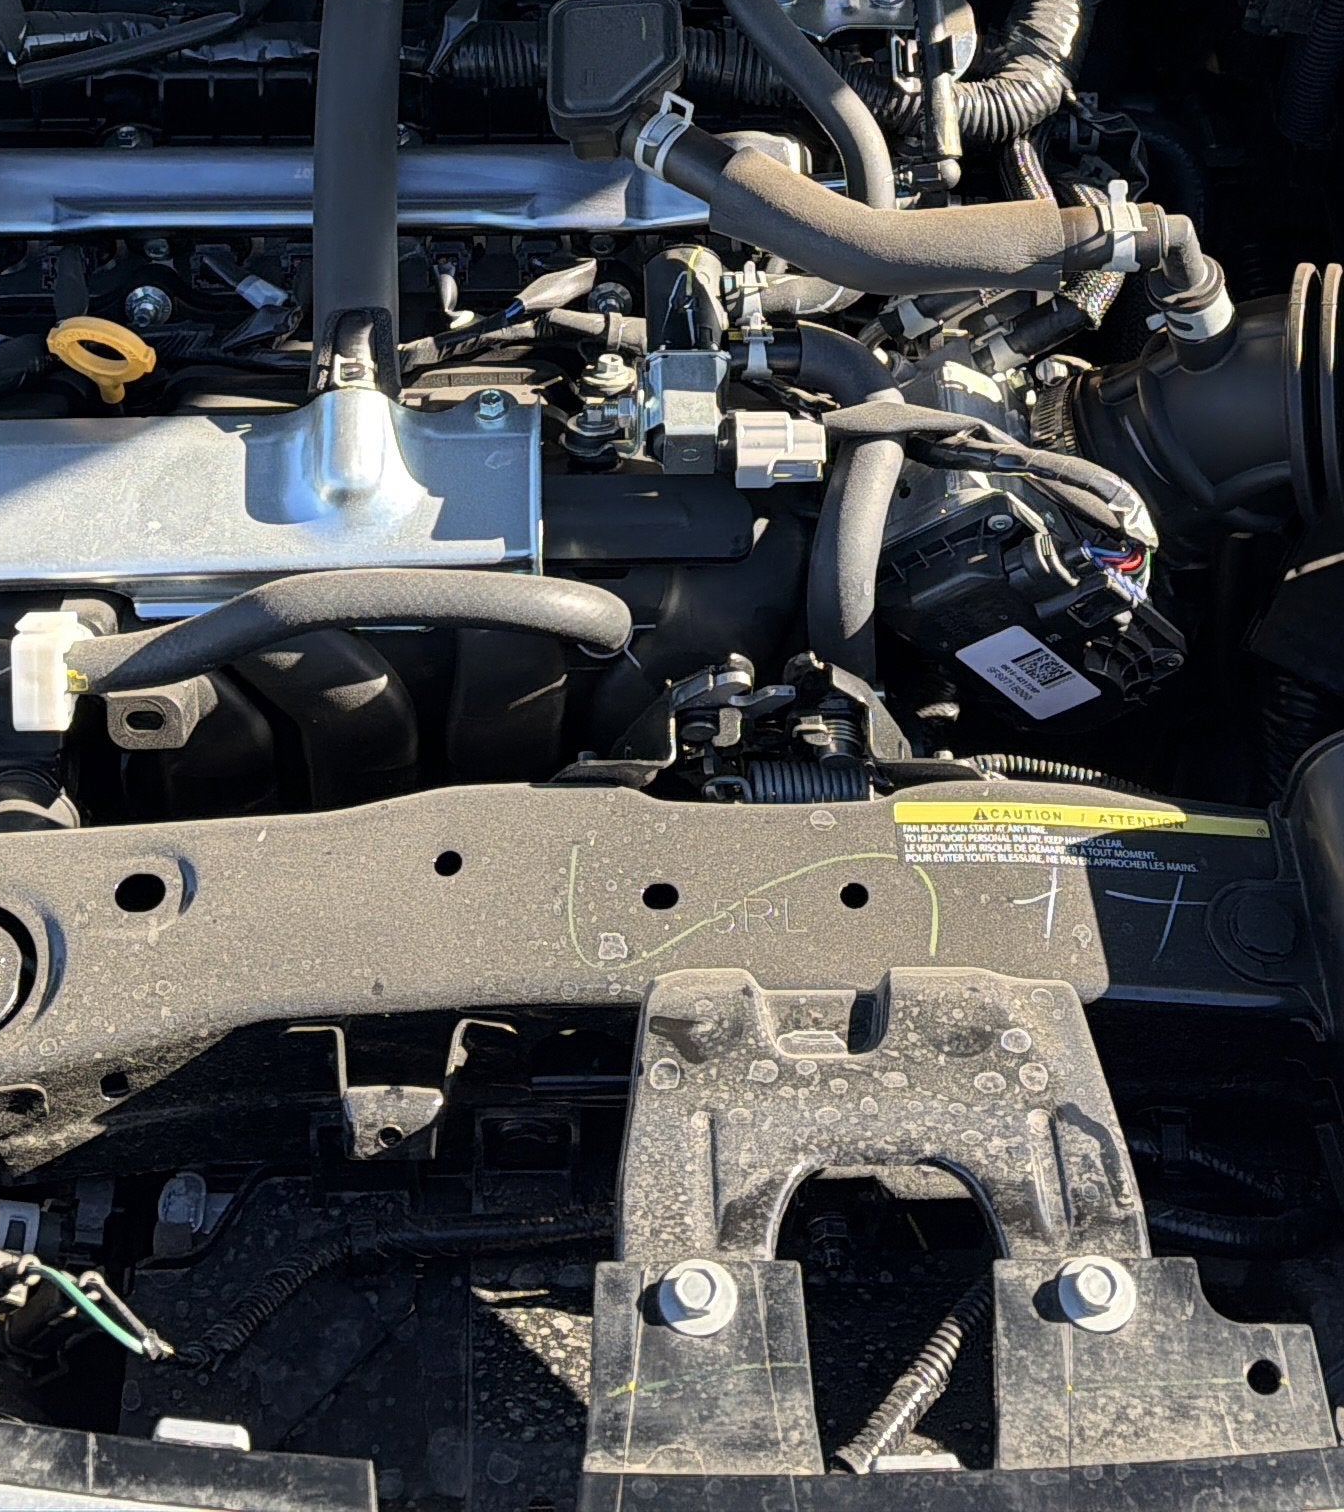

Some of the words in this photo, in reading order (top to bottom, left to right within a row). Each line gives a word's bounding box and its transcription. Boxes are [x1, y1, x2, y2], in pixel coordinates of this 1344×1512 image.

[990, 808, 1062, 822] CAUTION
[1098, 814, 1185, 830] ATTENTION
[903, 824, 919, 833] FAN
[920, 824, 948, 833] BLADE
[949, 825, 968, 833] CAN
[969, 825, 994, 833] START
[995, 825, 1006, 833] AT
[904, 834, 916, 843] TO
[917, 834, 939, 843] HELP
[940, 834, 967, 843] AVOID
[968, 834, 1011, 843] PERSONAL
[1044, 836, 1064, 845] KEEP
[1065, 836, 1094, 846] HANDS
[904, 844, 914, 853] LE
[916, 844, 977, 853] VENTILATEUR
[979, 844, 1012, 854] RISQUE
[1013, 845, 1027, 854] DE
[1088, 847, 1113, 857] TOUT
[906, 854, 932, 863] POUR
[965, 853, 997, 863] TOUTE
[1046, 855, 1059, 865] NE
[1060, 856, 1077, 866] PAS
[1078, 857, 1091, 867] EN
[1092, 858, 1149, 870] APPROCHER
[1150, 861, 1165, 871] LES
